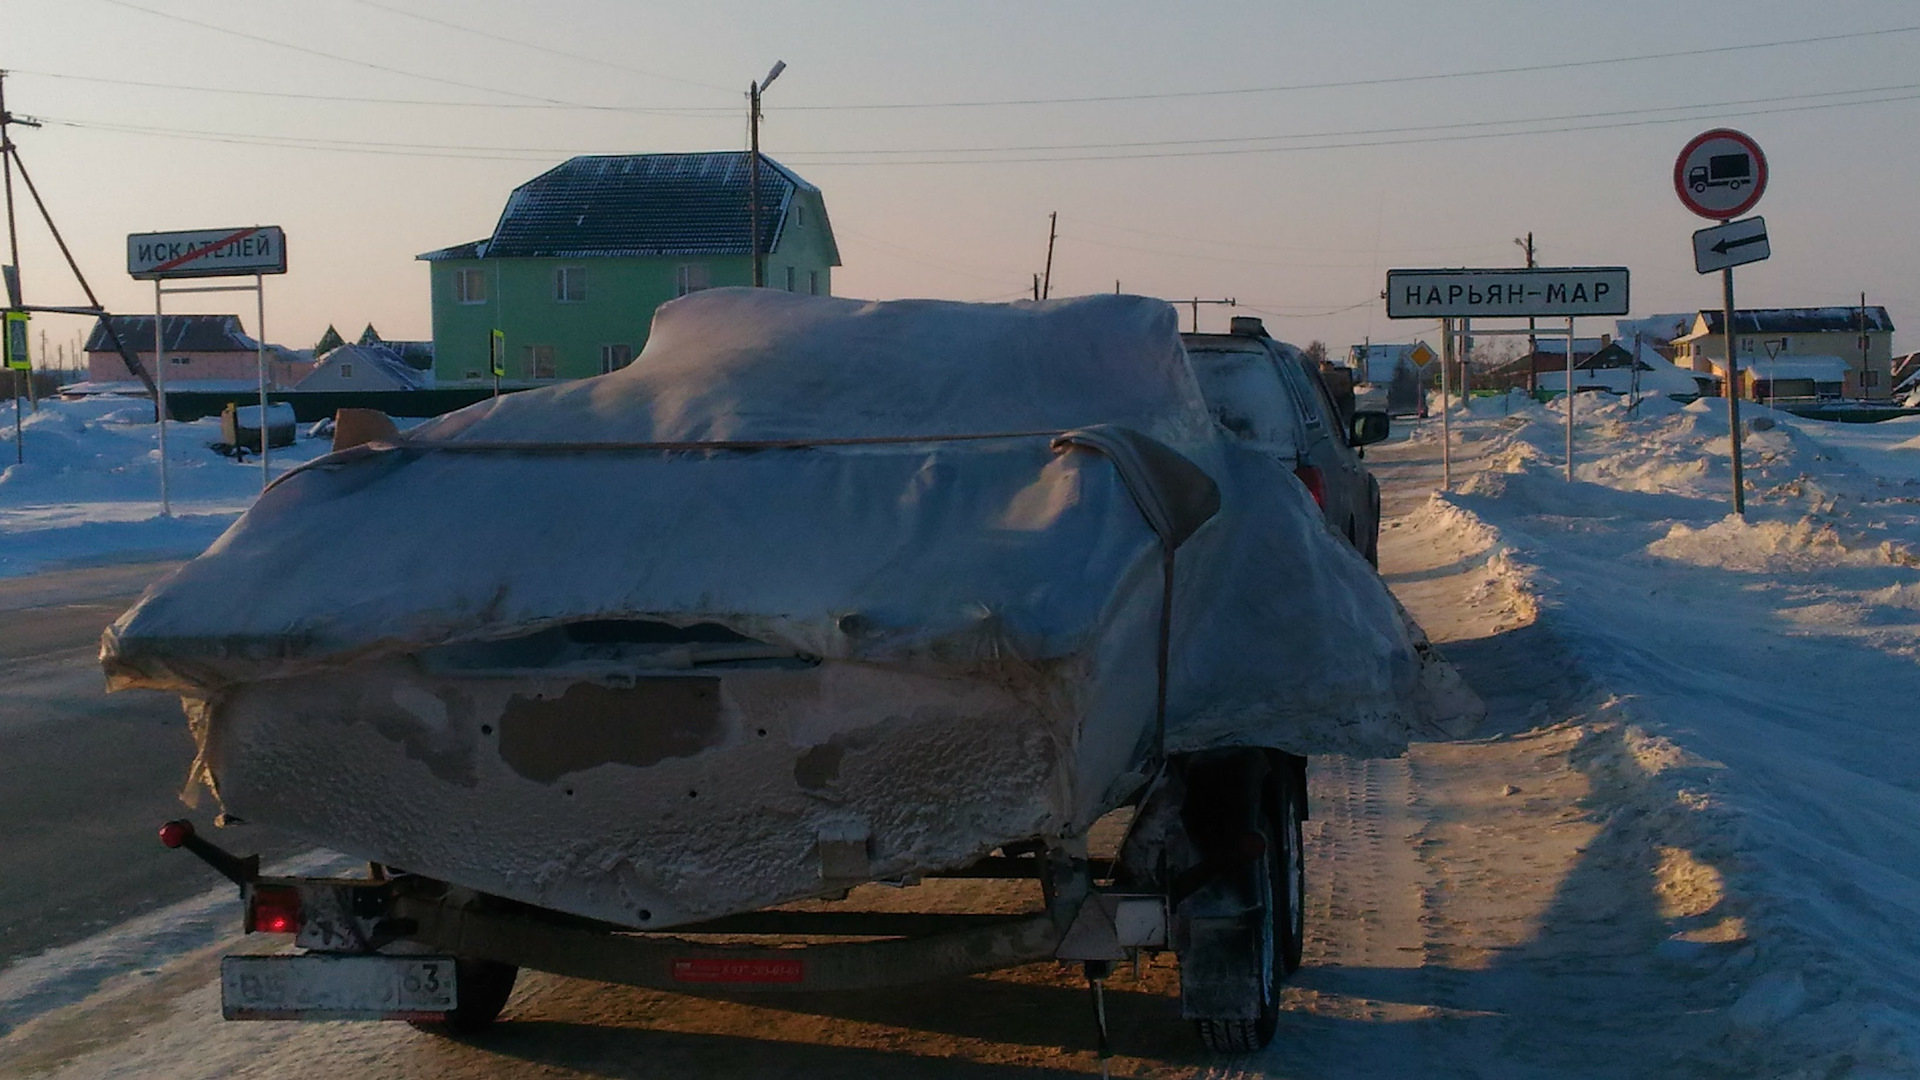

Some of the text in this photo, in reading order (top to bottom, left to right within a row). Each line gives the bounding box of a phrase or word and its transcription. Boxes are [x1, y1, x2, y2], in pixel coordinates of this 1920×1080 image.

[138, 234, 270, 262] ИСКАТЕЛЕЙ
[1406, 282, 1610, 305] НАРЬЯН-МАР
[403, 963, 440, 993] 63
